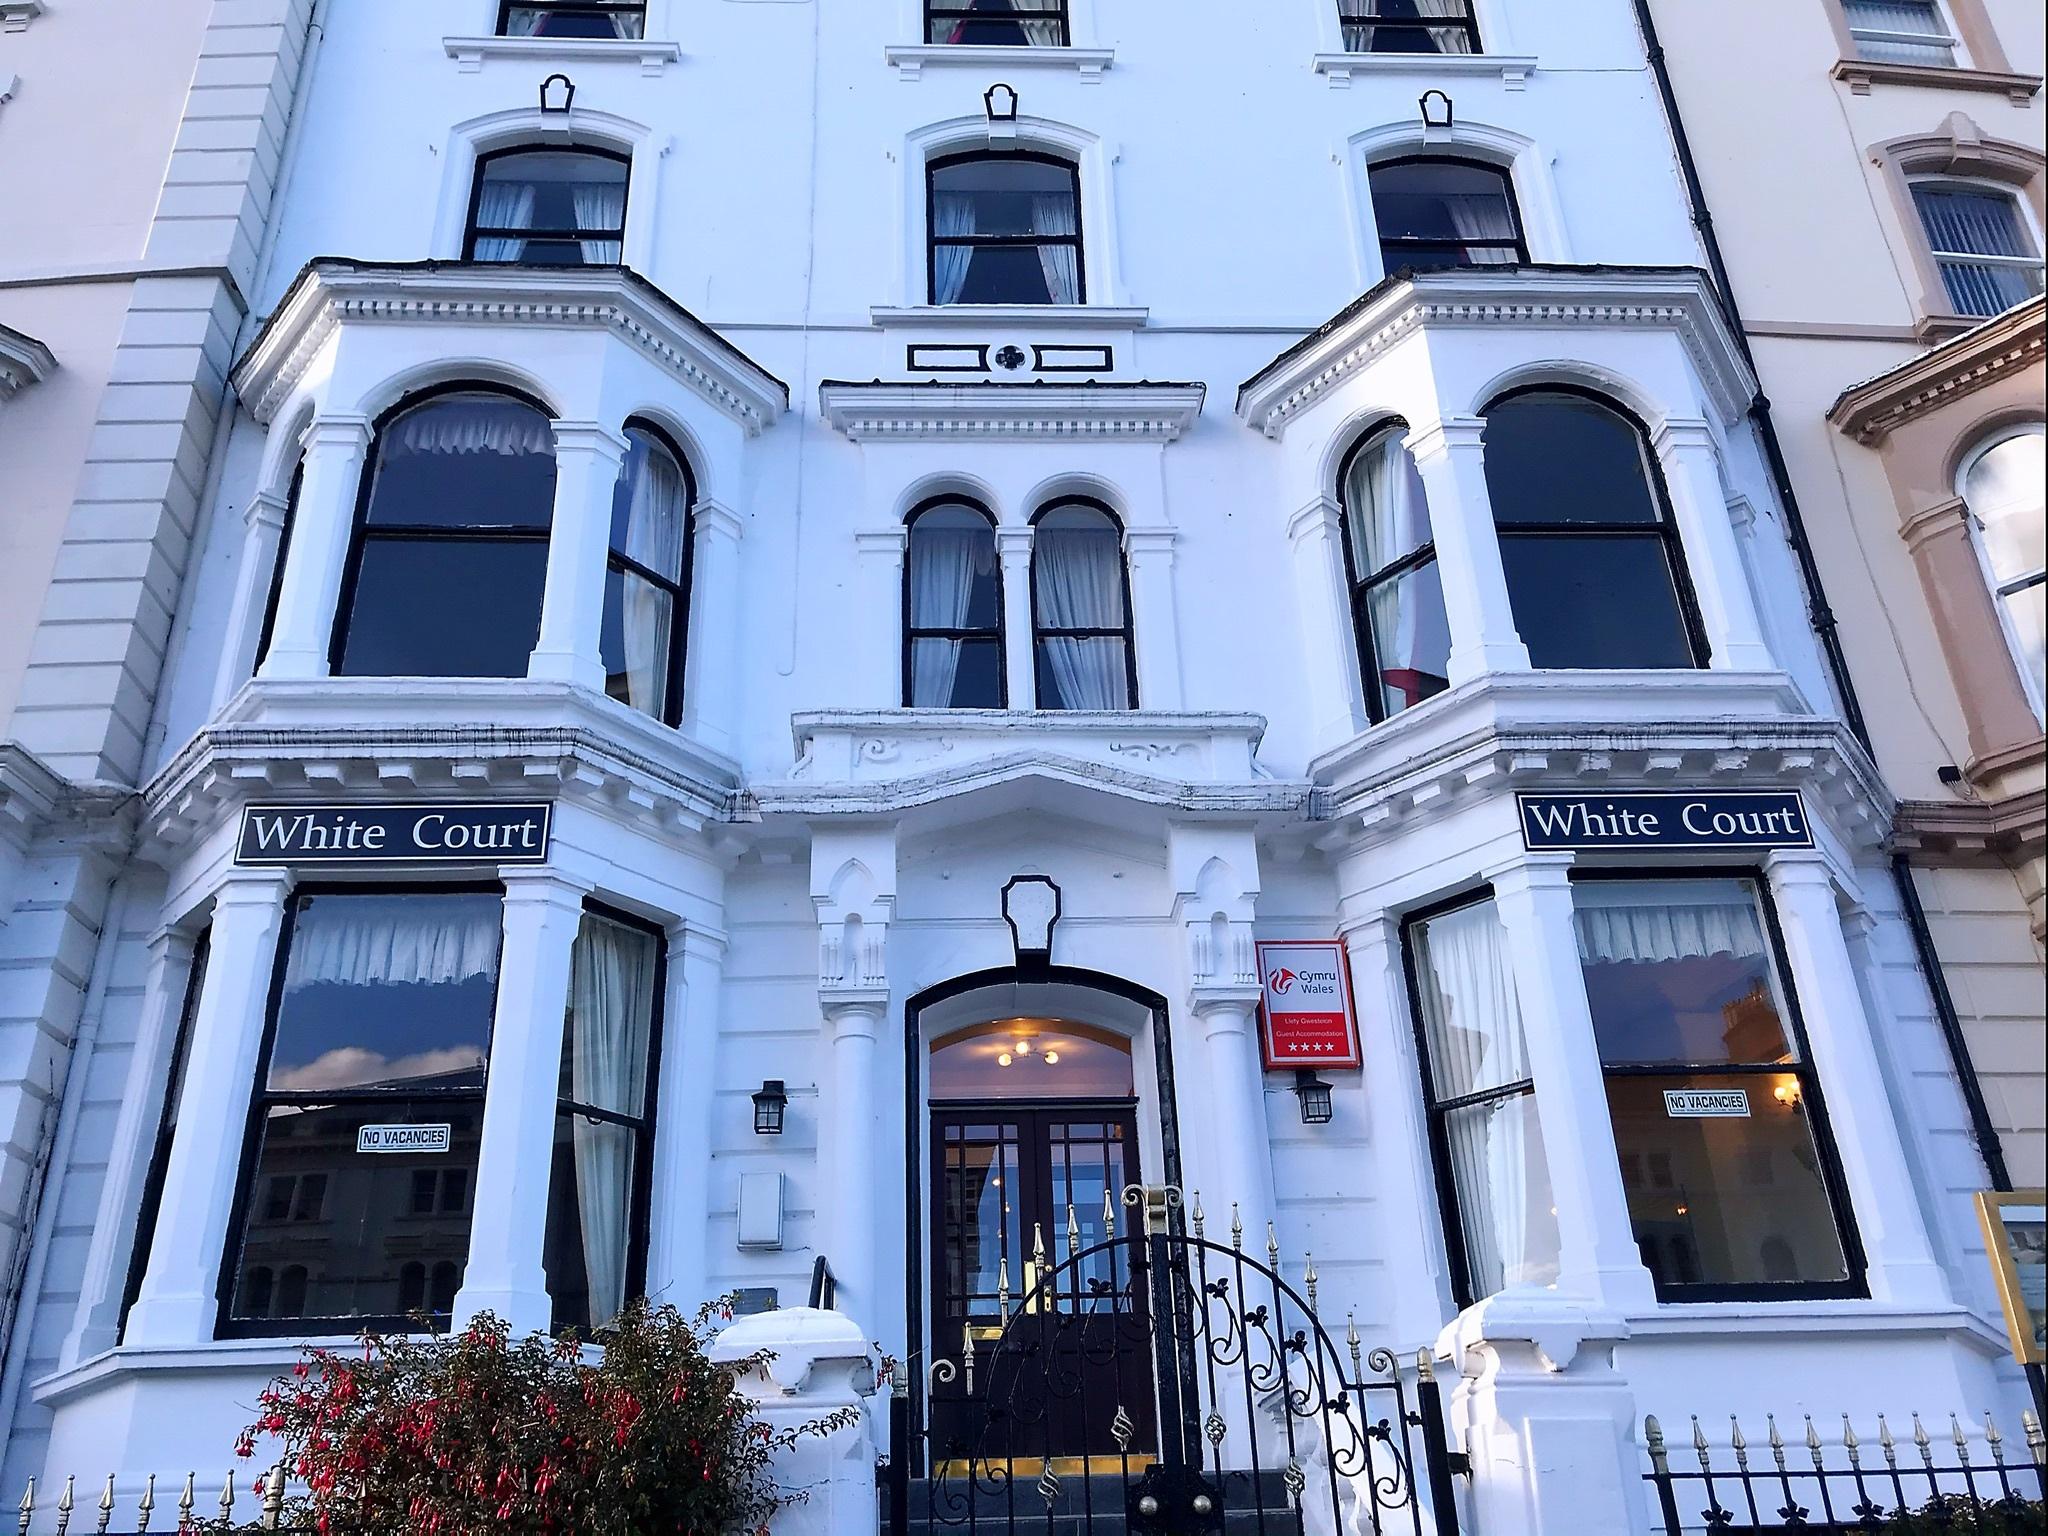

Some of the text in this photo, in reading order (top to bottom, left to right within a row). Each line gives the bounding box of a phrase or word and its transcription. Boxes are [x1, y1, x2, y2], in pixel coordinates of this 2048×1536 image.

[1527, 802, 1801, 837] White Court
[251, 813, 538, 850] White Court
[1299, 970, 1336, 983] Cymru
[1301, 984, 1334, 994] Wales
[1670, 1095, 1744, 1108] NO VACANCIES
[363, 1130, 445, 1144] NO VACANCIES
